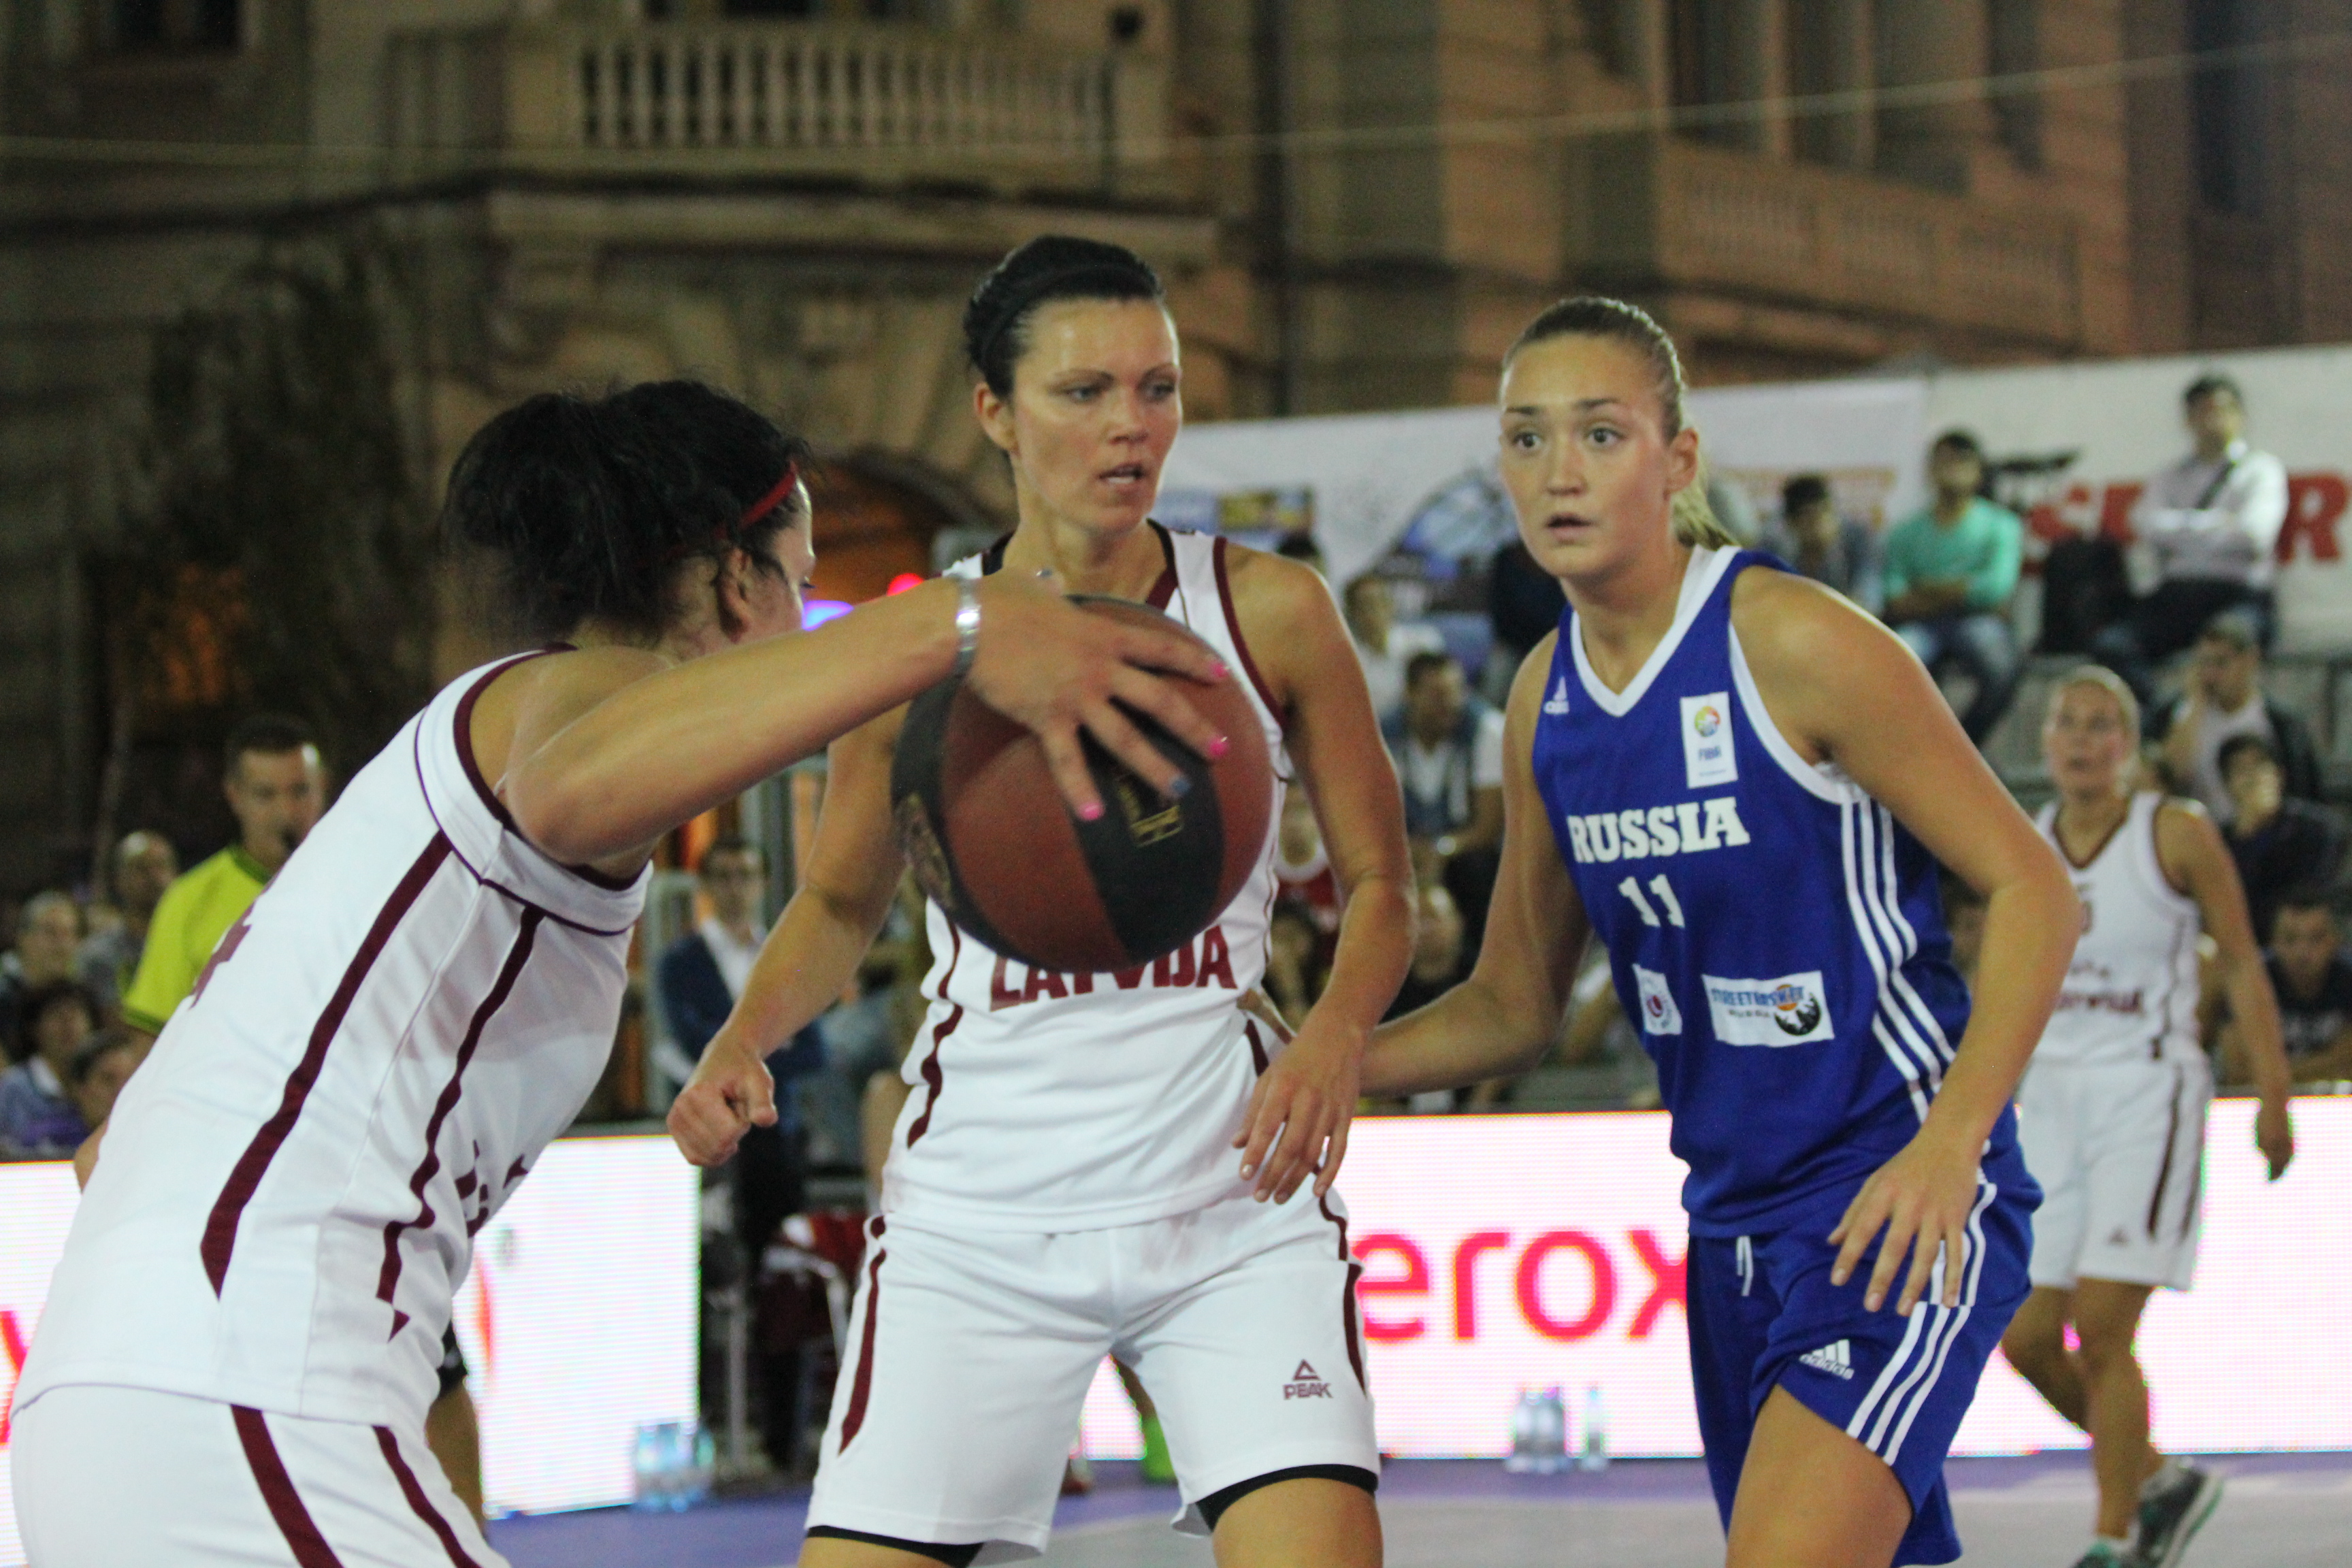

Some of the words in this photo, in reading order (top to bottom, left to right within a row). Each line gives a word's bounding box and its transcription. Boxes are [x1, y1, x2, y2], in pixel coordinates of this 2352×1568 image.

[1567, 796, 1751, 864] RUSSIA
[1618, 874, 1686, 928] 11
[1799, 1353, 1855, 1380] adidas
[1282, 1382, 1333, 1401] PEAK
